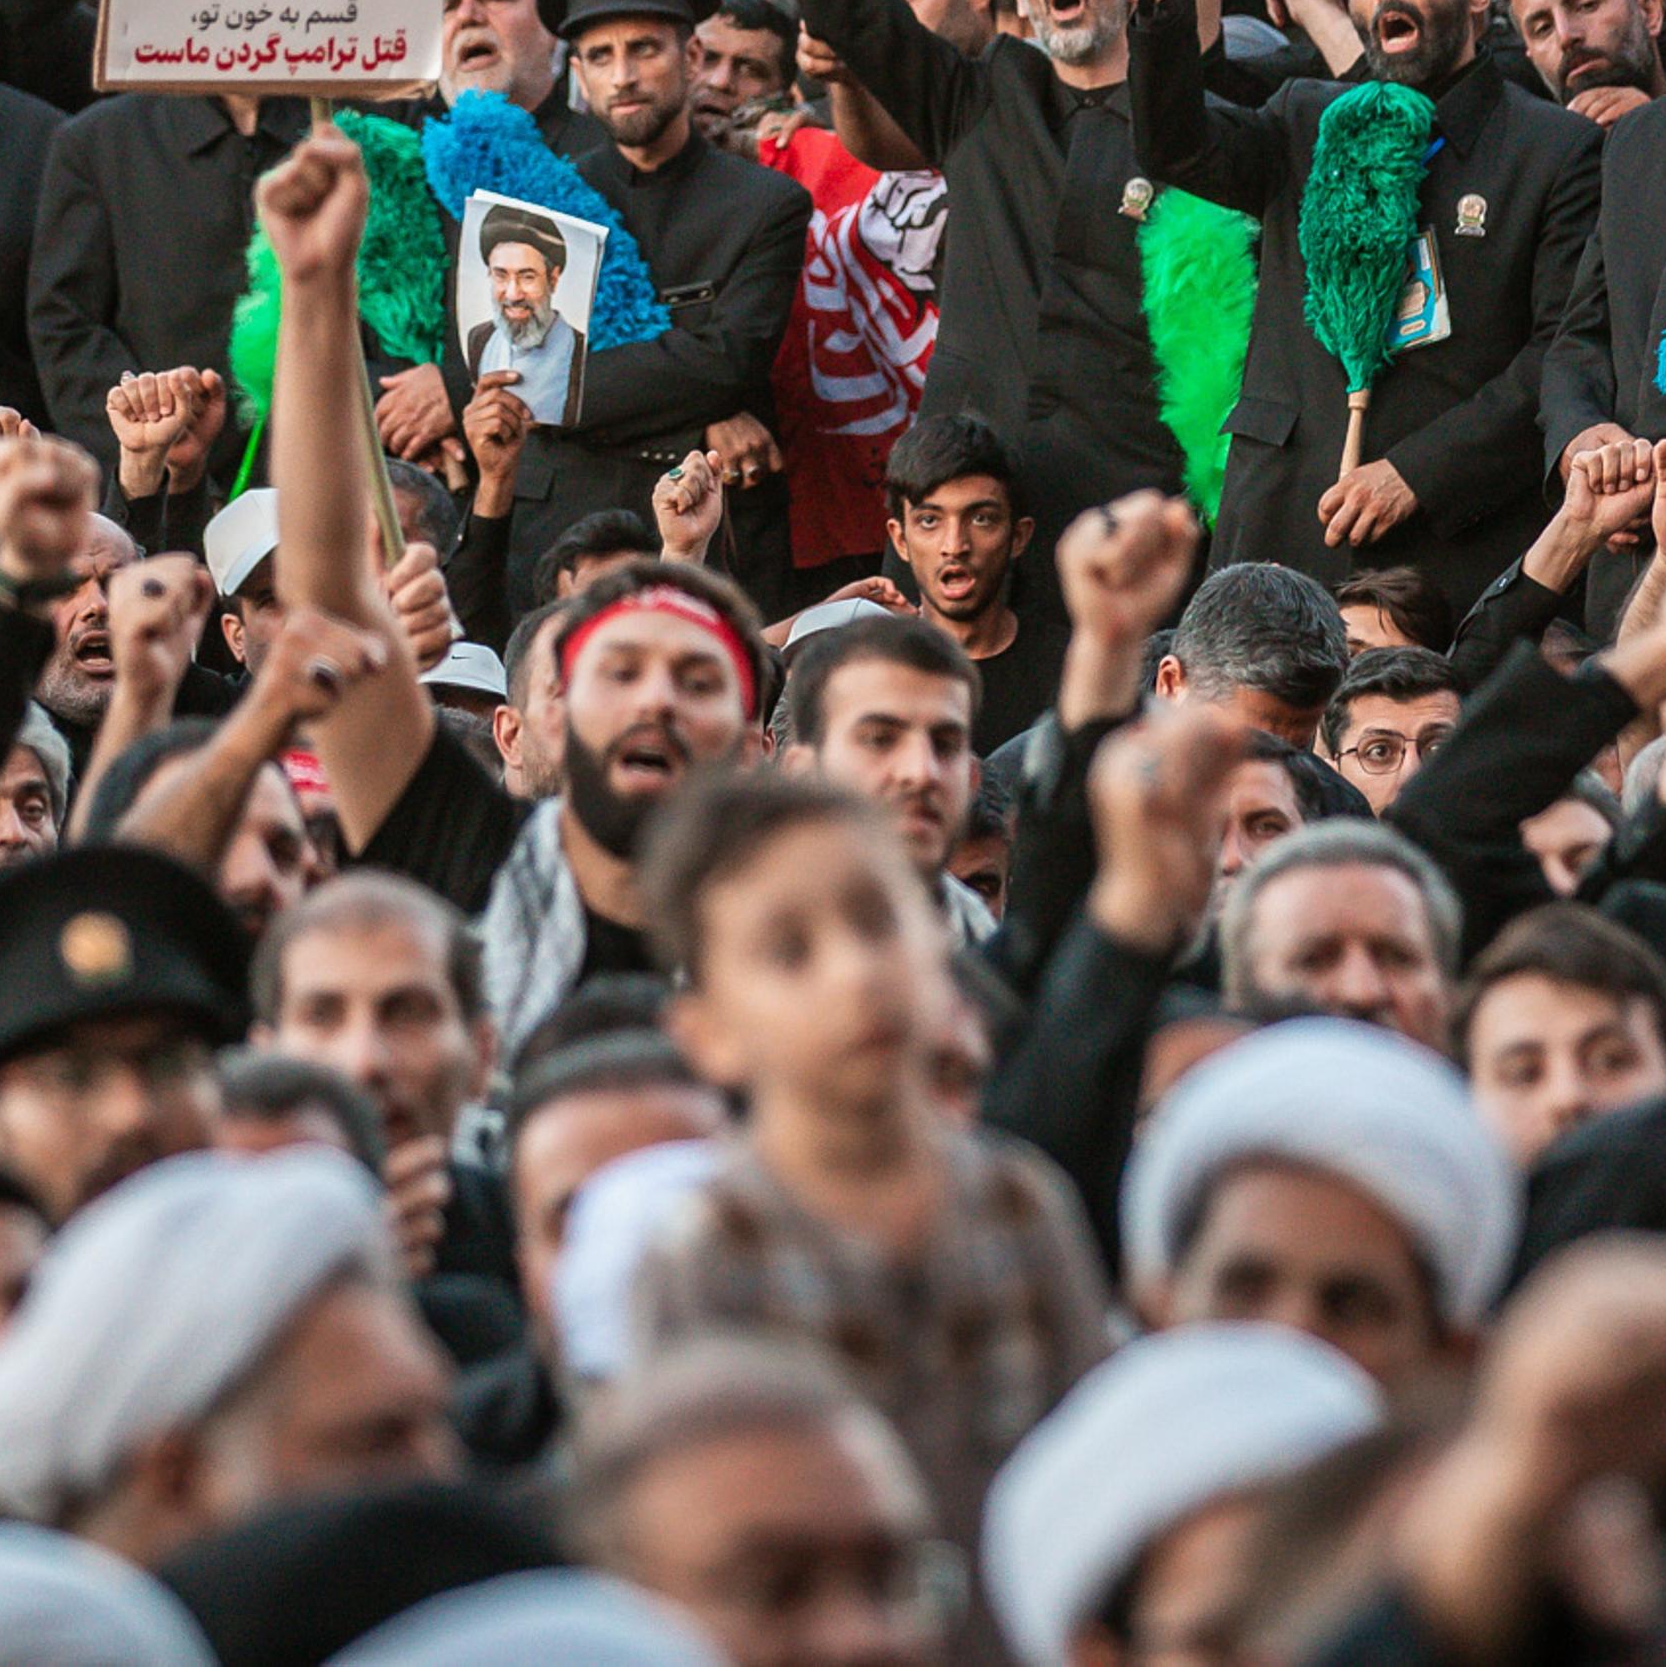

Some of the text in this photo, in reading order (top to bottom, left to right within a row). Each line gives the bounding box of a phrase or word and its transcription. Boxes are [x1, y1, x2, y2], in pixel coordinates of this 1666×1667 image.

[226, 1, 273, 29] خون
[280, 8, 299, 30] به
[135, 29, 407, 76] قتل ترامپ گردن ماست
